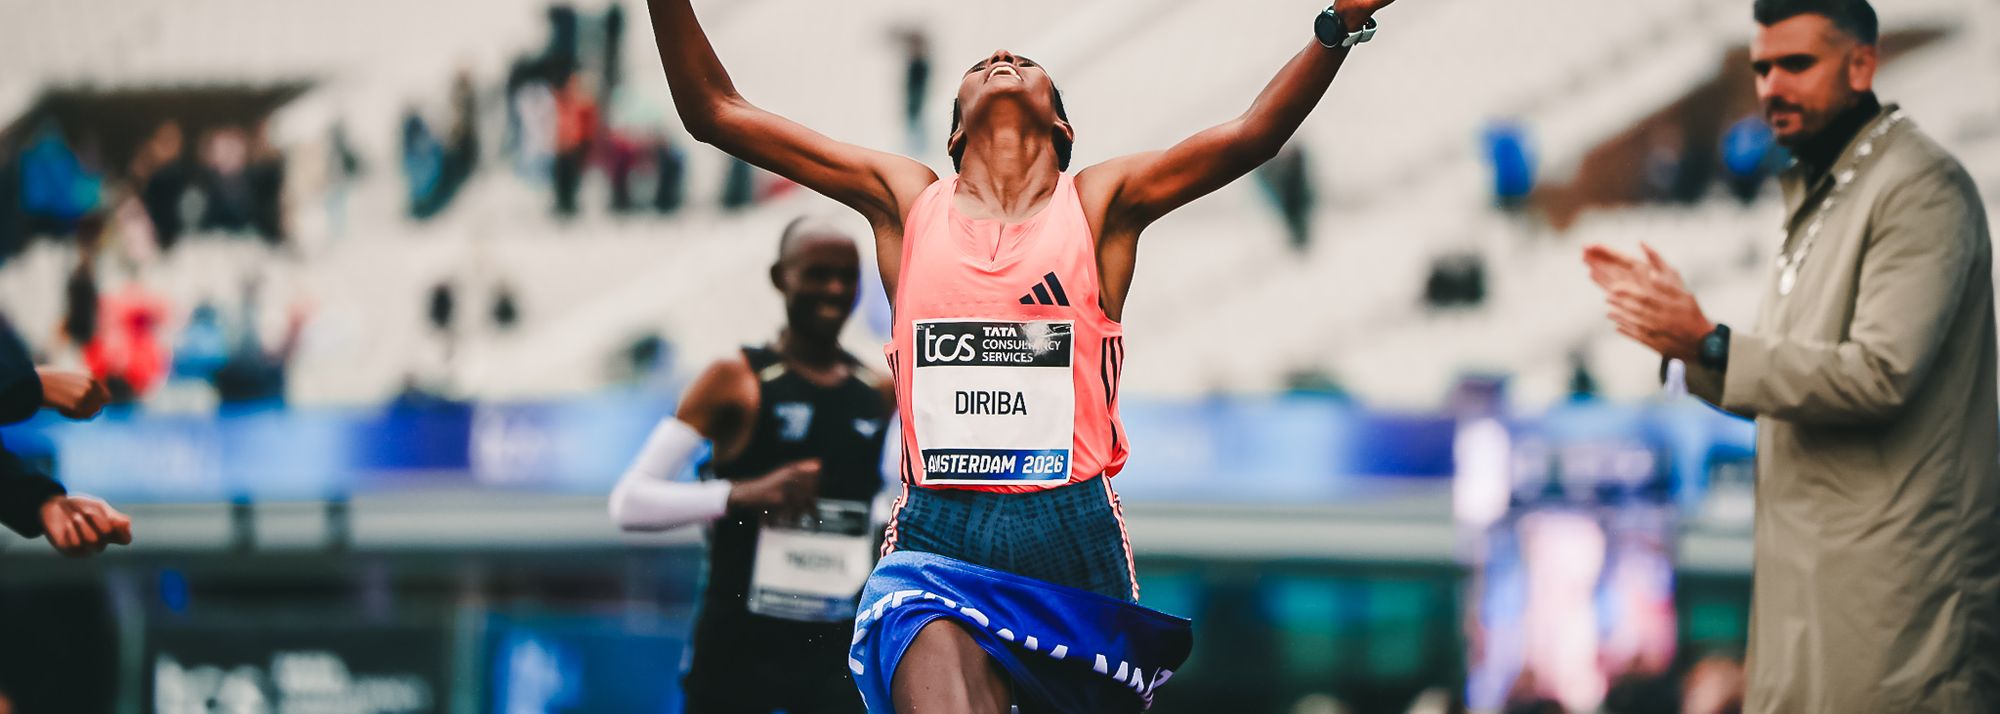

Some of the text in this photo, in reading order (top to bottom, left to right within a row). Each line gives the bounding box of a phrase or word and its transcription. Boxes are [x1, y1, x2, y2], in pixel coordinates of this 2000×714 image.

[982, 326, 1017, 337] TATA
[925, 325, 975, 362] tcs
[982, 339, 1061, 350] CONSULCY
[982, 351, 1034, 363] SERVICES
[955, 391, 1027, 415] DIRIBA
[1022, 454, 1064, 474] 2026
